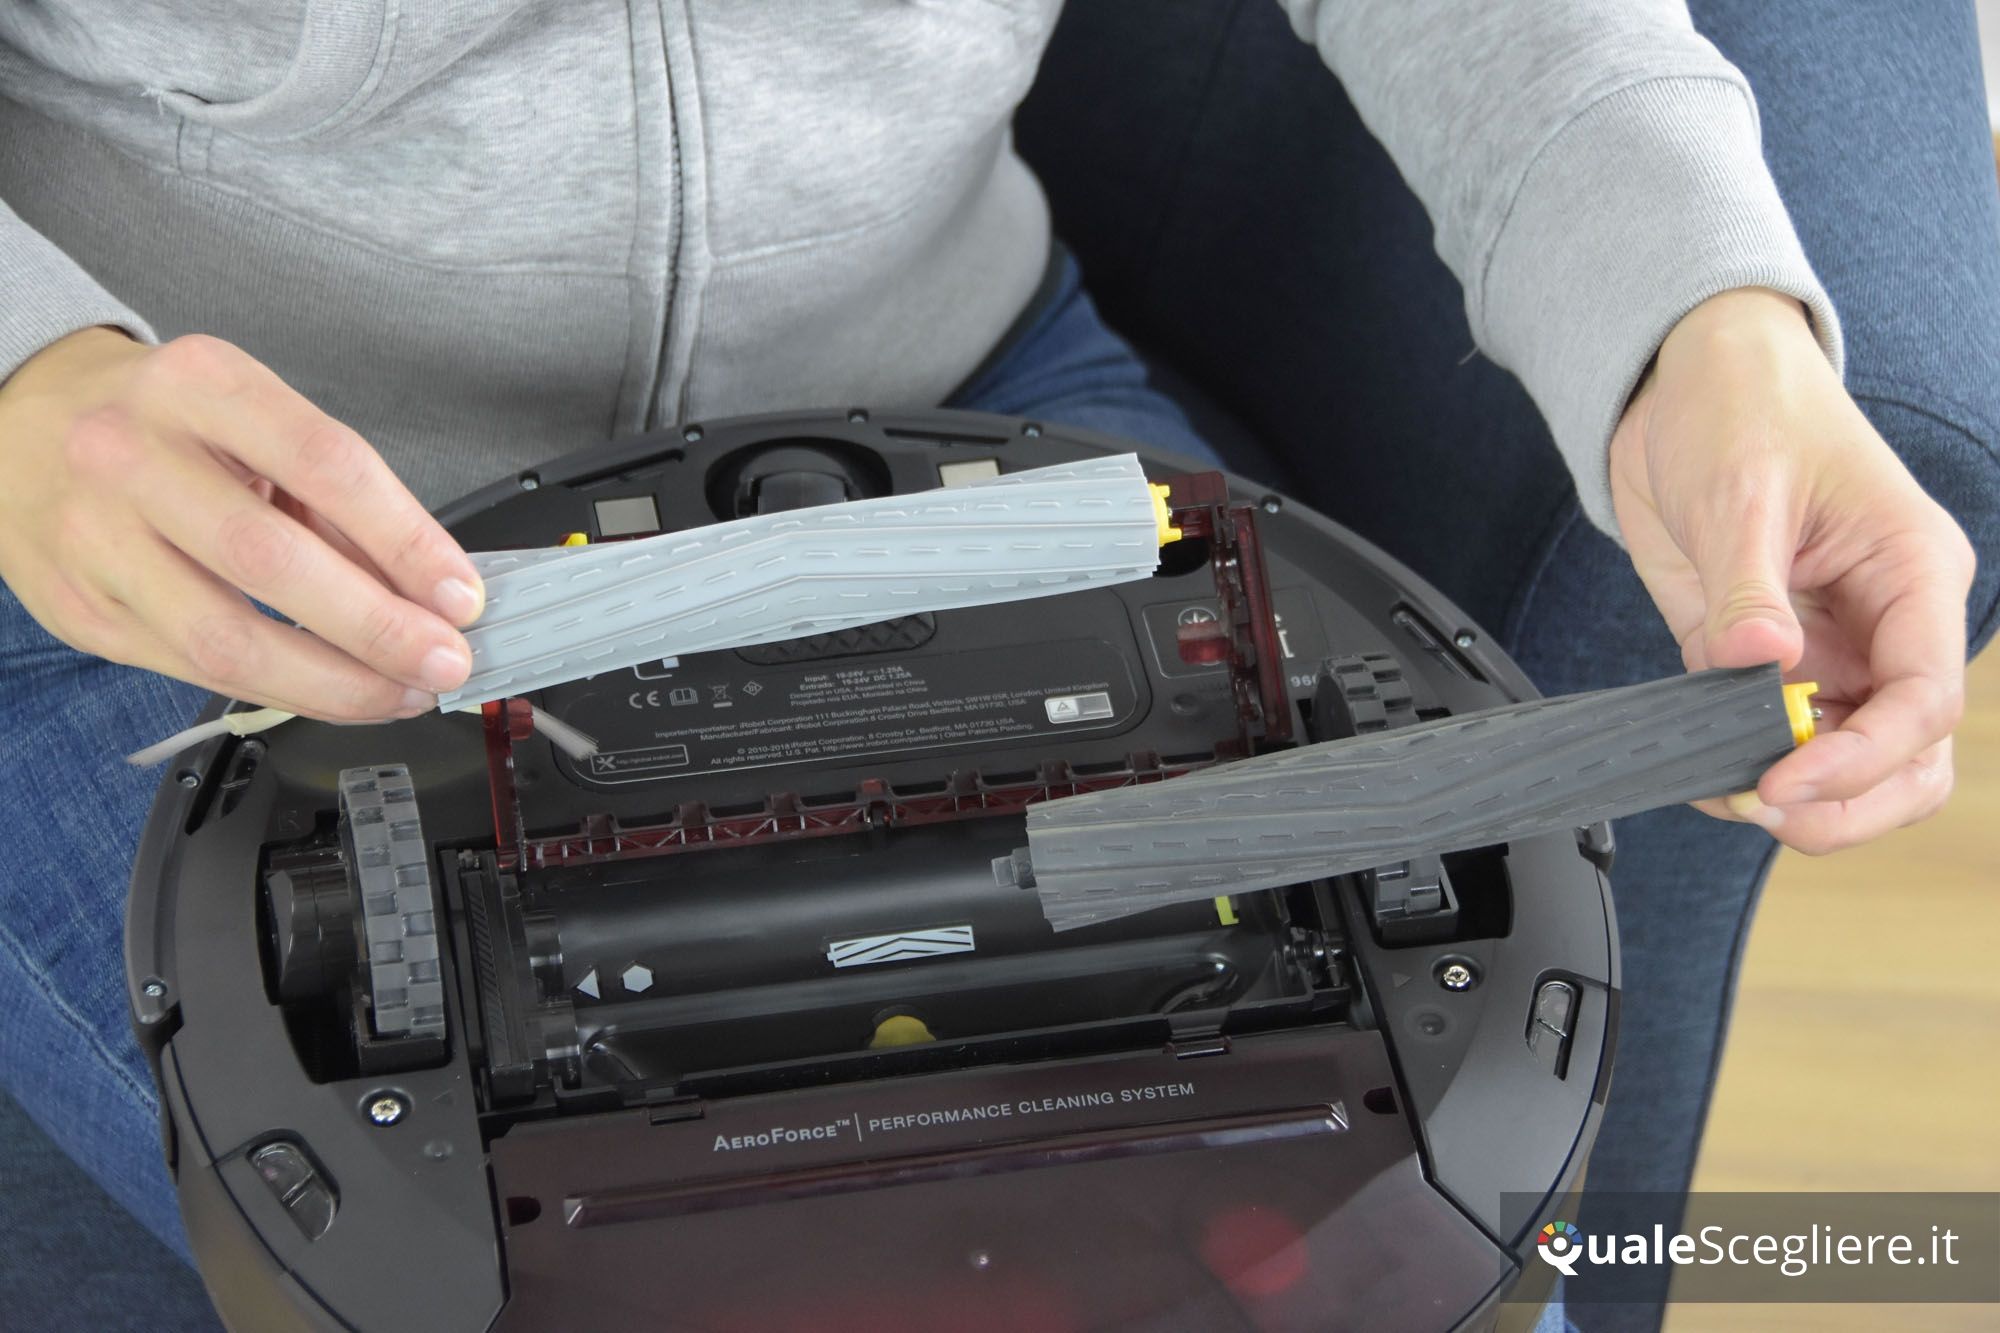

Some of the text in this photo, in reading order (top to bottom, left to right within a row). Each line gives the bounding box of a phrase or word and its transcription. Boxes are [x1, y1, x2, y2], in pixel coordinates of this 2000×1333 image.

[800, 682, 835, 690] Entrada:
[889, 673, 912, 681] 1.25A
[804, 674, 828, 683] Input:
[880, 666, 904, 674] 1.25A
[789, 690, 824, 701] Designed
[855, 682, 894, 692] Assembled
[904, 678, 926, 686] China
[790, 697, 826, 707] Projetado
[862, 689, 895, 698] Montado
[906, 685, 928, 693] China
[740, 720, 766, 728] iRobot
[767, 715, 814, 726] Corporation
[831, 708, 881, 719] Buckingham
[882, 705, 907, 713] Palace
[909, 702, 931, 710] Road,
[932, 699, 963, 707] Victoria,
[1011, 690, 1043, 698] London,
[1044, 687, 1072, 695] United
[1072, 683, 1109, 693] Kingdom
[795, 722, 822, 730] iRobot
[823, 717, 868, 728] Corporation
[877, 713, 905, 722] Crosby
[907, 710, 928, 718] Drive
[791, 741, 817, 749] iRobot
[875, 731, 904, 740] Crosby
[996, 718, 1015, 726] USA
[723, 756, 745, 764] rights
[944, 731, 966, 739] Other
[968, 728, 999, 736] Patents
[869, 1103, 1012, 1132] PERFORMANCE
[1018, 1092, 1114, 1114] CLEANING
[1121, 1082, 1195, 1103] SYSTEM
